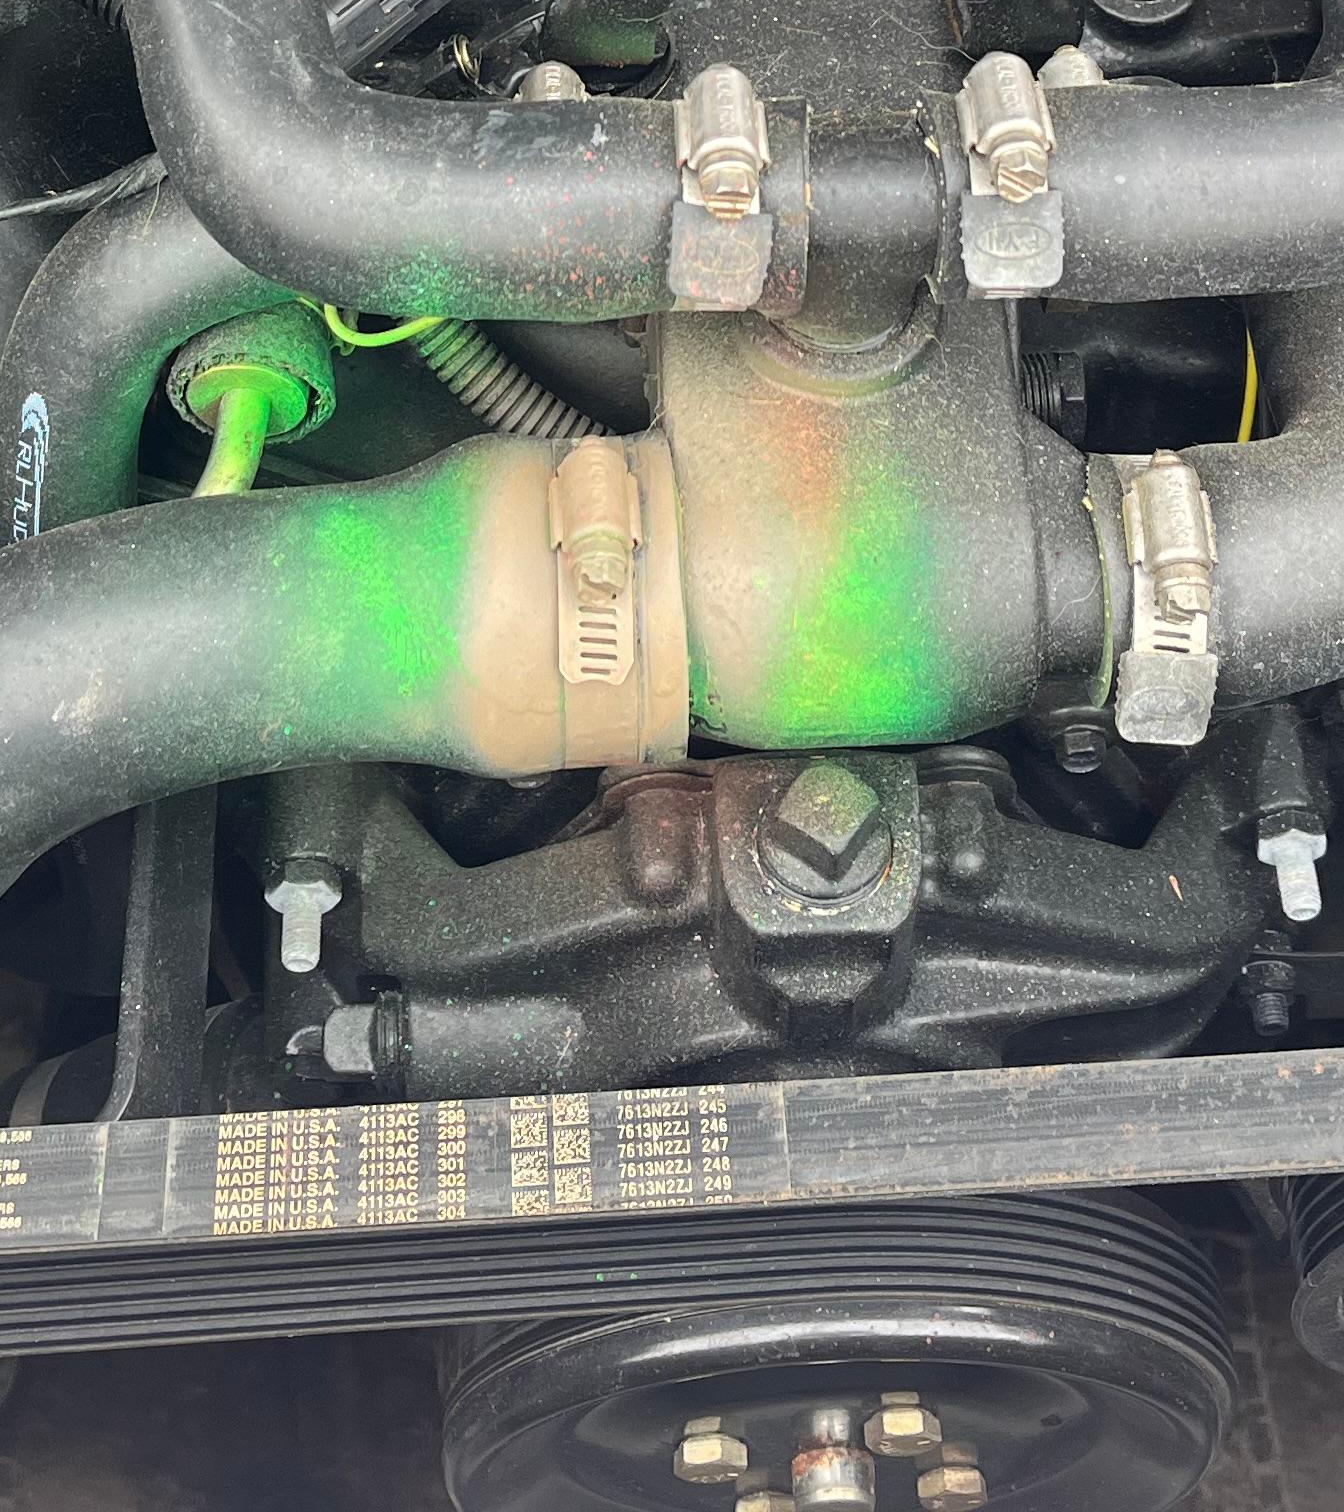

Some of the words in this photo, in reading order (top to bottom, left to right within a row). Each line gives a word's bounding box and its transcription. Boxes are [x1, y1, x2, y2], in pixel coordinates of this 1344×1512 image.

[616, 1102, 689, 1120] 7613N2ZJ
[699, 1099, 727, 1114] 245
[218, 1124, 268, 1139] MADE
[271, 1122, 287, 1136] IN
[293, 1119, 340, 1134] U.S.A.
[359, 1113, 419, 1129] 4113AC
[437, 1110, 466, 1124] 298
[217, 1156, 266, 1171] MADE
[270, 1153, 287, 1168] IN
[292, 1151, 340, 1166] U.S.A.
[359, 1145, 419, 1160] 4113AC
[437, 1142, 466, 1156] 300
[618, 1140, 691, 1158] 7613N2ZJ
[701, 1137, 729, 1153] 247
[619, 1178, 693, 1197] 7613N2ZJ
[704, 1175, 732, 1191] 249
[213, 1220, 263, 1236] MADE
[267, 1218, 284, 1232] IN
[288, 1215, 338, 1230] U.S.A.
[357, 1209, 418, 1225] 4113AC
[437, 1205, 466, 1220] 304
